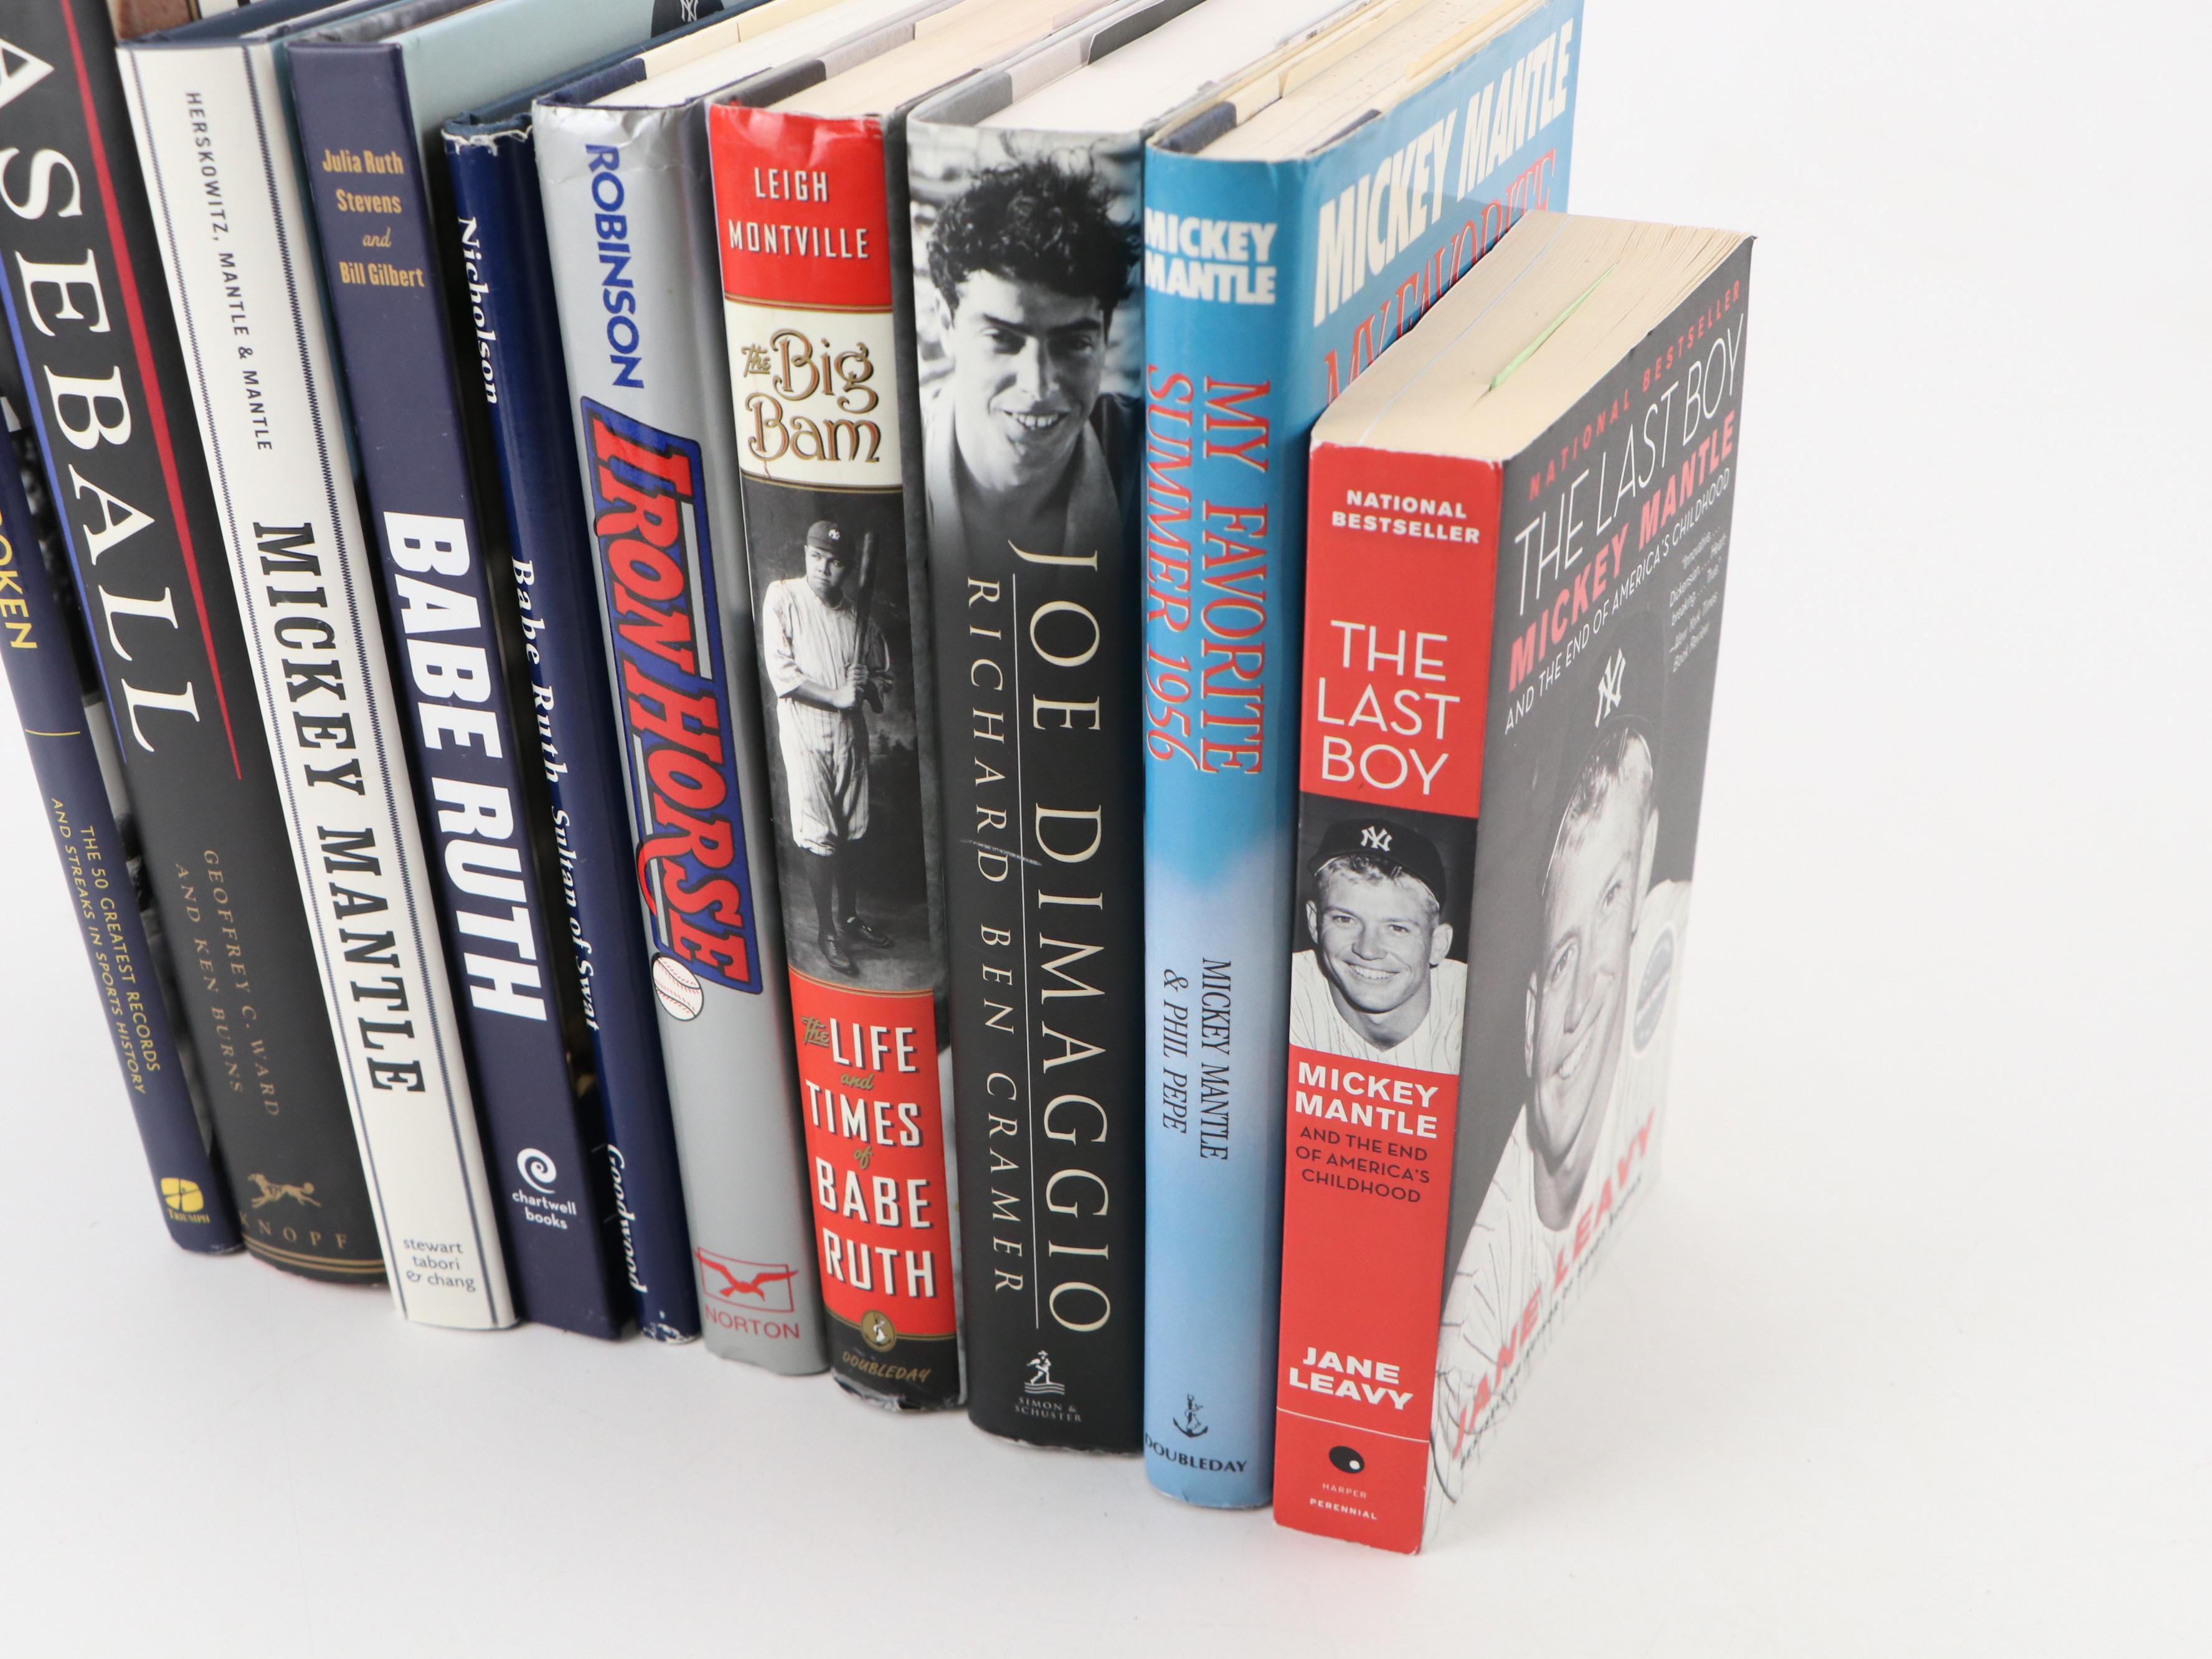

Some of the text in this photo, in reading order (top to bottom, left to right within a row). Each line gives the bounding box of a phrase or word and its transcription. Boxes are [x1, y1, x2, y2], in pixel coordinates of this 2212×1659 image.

[323, 149, 405, 175] Julia Ruth
[754, 167, 829, 202] LEIGH
[1313, 17, 1575, 328] MICKEY MANTLE
[335, 189, 403, 215] Stevens
[362, 227, 392, 248] and
[728, 219, 869, 259] MONTVILLE
[1145, 207, 1277, 263] MICKEY
[186, 90, 273, 450] HERSKOWITZ, MANTLE & MANTLE
[339, 262, 426, 288] Bill Gilbert
[584, 143, 645, 389] ROBINSON
[1145, 249, 1277, 305] MANTLE
[456, 216, 499, 405] Nicholson
[770, 328, 879, 414] Big
[1529, 279, 1741, 501] NATIONAL BESTSELLER
[745, 392, 881, 463] Bam
[1515, 313, 1744, 616] THE LAST BOY
[1331, 511, 1480, 544] BESTSELLER
[1346, 489, 1467, 519] NATIONAL
[1145, 364, 1201, 770] SUMMER 1956
[1200, 376, 1270, 774] MY FAVORITE
[1509, 409, 1735, 692] MICKEY MANTLE
[1505, 686, 1535, 735] AND
[1539, 653, 1562, 697] THE
[1566, 623, 1590, 668] END
[1593, 599, 1610, 635] OF
[1672, 468, 1730, 546] CHILDHOOD
[1330, 620, 1449, 683] THE
[591, 416, 749, 985] IRON HORSE
[1317, 676, 1461, 741] LAST
[383, 511, 548, 1022] BABE RUTH
[511, 555, 600, 1032] Babe Ruth Sultan of Swat
[1321, 735, 1449, 796] BOY
[252, 521, 426, 1093] MICKEY MANTLE
[51, 798, 146, 1094] AND STREAKS IN SPORTS HISTORY
[81, 826, 161, 1072] THE 50 GREATEST RECORDS
[967, 577, 1024, 1293] RICHARD BEN CRAMER
[1008, 539, 1112, 1333] JOE DIMAGGIO
[175, 863, 243, 1092] AND KEN BURNS
[204, 849, 280, 1116] GEOFFREY C. WARD
[829, 1018, 920, 1073] LIFE
[1162, 968, 1189, 1134] & PHIL PEPE
[1200, 957, 1231, 1161] MICKEY MANTLE
[840, 1072, 875, 1091] and
[1298, 1061, 1439, 1108] MICKEY
[805, 1079, 922, 1147] TIMES
[1295, 1090, 1437, 1139] MANTLE
[854, 1146, 873, 1170] of
[1295, 1146, 1430, 1184] OF AMERICA'S
[1300, 1126, 1428, 1161] AND THE END
[512, 1189, 577, 1216] chartwell
[815, 1156, 933, 1229] BABE
[1302, 1168, 1420, 1203] CHILDHOOD
[239, 1211, 347, 1249] KNOPF
[524, 1206, 567, 1230] books
[607, 1143, 648, 1293] Goodwood
[404, 1239, 463, 1254] stewart
[412, 1255, 460, 1270] tabori
[822, 1227, 937, 1298] RUTH
[406, 1270, 476, 1292] & chang
[1452, 1106, 1655, 1460] JANE LEAVY
[704, 1304, 801, 1340] NORTON
[842, 1351, 932, 1382] DOUBLEDAY
[1289, 1366, 1414, 1411] LEAVY
[1302, 1346, 1400, 1385] JANE
[1014, 1404, 1082, 1422] SCHUSTER
[1019, 1396, 1077, 1413] SIMON &
[1144, 1433, 1247, 1473] DOUBLEDAY
[1310, 1497, 1377, 1521] PERENNIAL
[1322, 1482, 1367, 1499] HARPER
